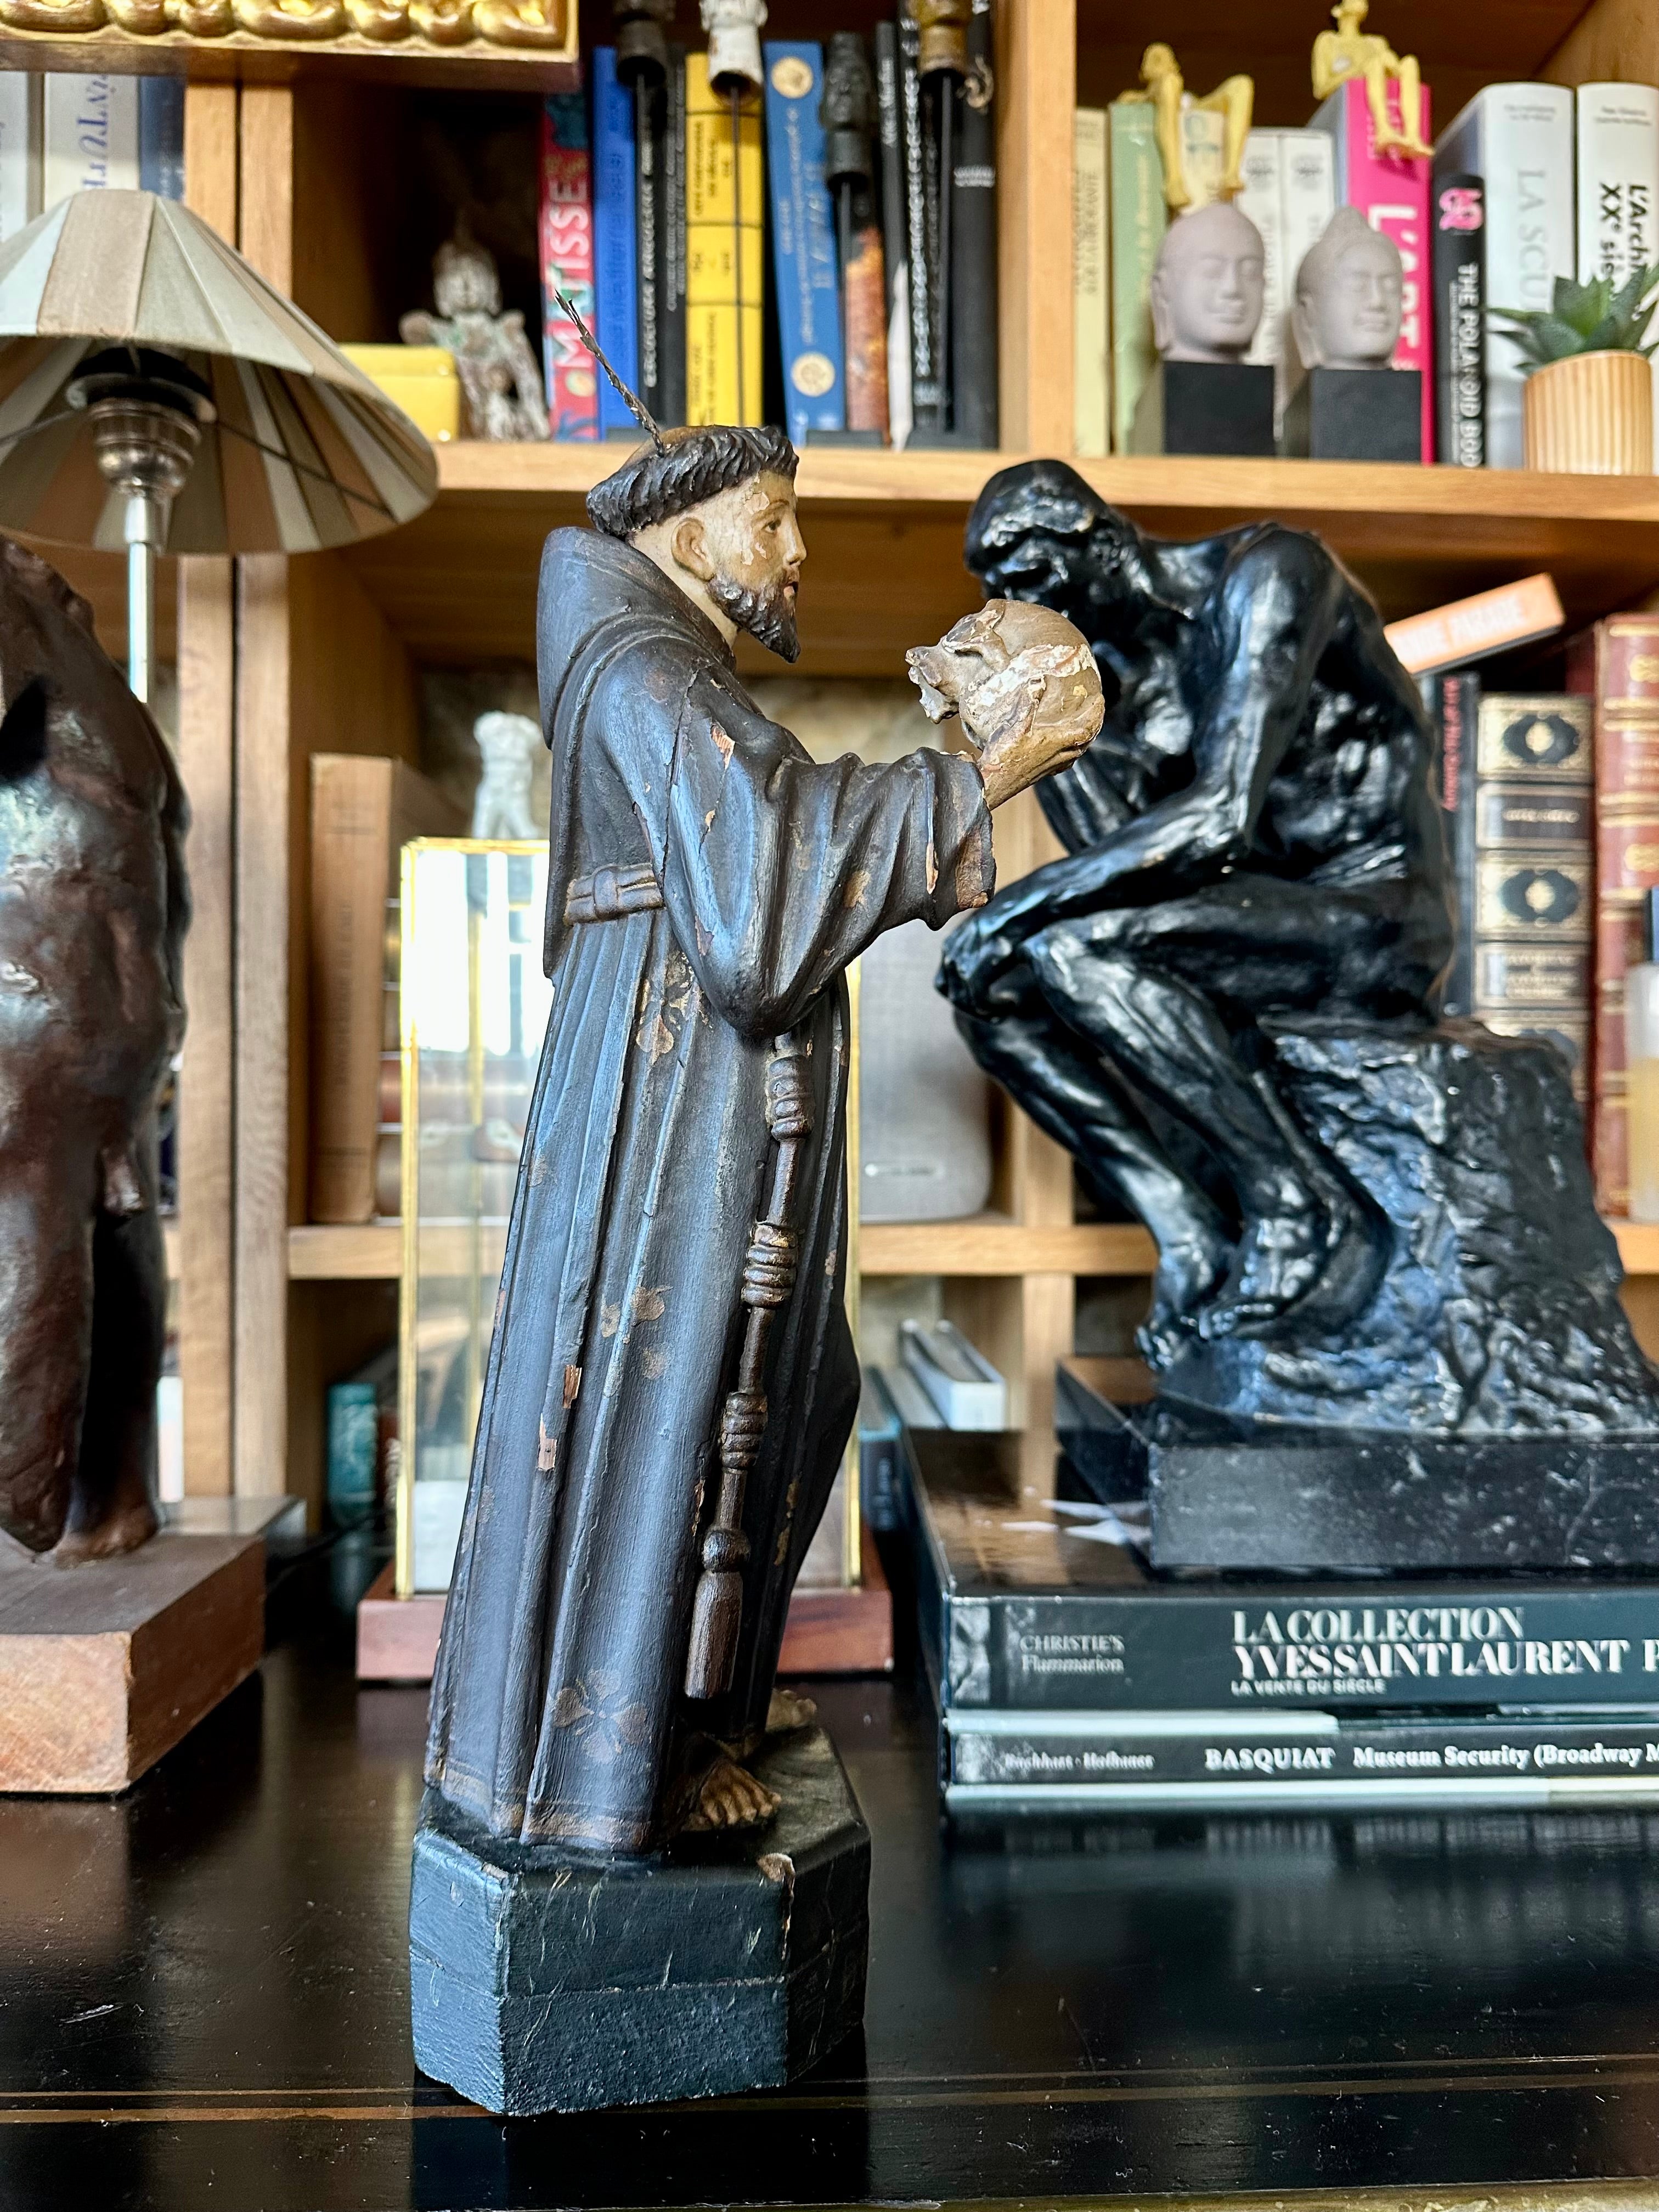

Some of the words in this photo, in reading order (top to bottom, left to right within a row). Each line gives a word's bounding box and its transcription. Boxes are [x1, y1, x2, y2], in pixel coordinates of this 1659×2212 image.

[1517, 170, 1547, 213] LA
[548, 179, 594, 369] MATISSE
[1518, 222, 1550, 311] SCU
[1599, 240, 1625, 276] siè
[1457, 262, 1480, 307] THE
[1458, 308, 1482, 418] POLAROID
[1460, 418, 1483, 467] BOO
[1019, 1634, 1125, 1654] CHRISTIE'S
[1232, 1609, 1285, 1644] LA
[1286, 1606, 1525, 1644] COLLECTION
[1021, 1654, 1124, 1673] Flammarion
[1233, 1644, 1333, 1679] YVES
[1333, 1641, 1448, 1678] SAINT
[1450, 1639, 1631, 1676] LAURENT
[1641, 1639, 1659, 1672] P
[1231, 1679, 1254, 1696] LA
[1255, 1679, 1305, 1696] VENTE
[1306, 1678, 1331, 1695] DU
[1205, 1747, 1336, 1774] BASQUIAT
[1353, 1746, 1442, 1769] Museum
[1444, 1744, 1531, 1771] Security
[1533, 1742, 1643, 1769] (Broadway
[1645, 1742, 1659, 1763] M
